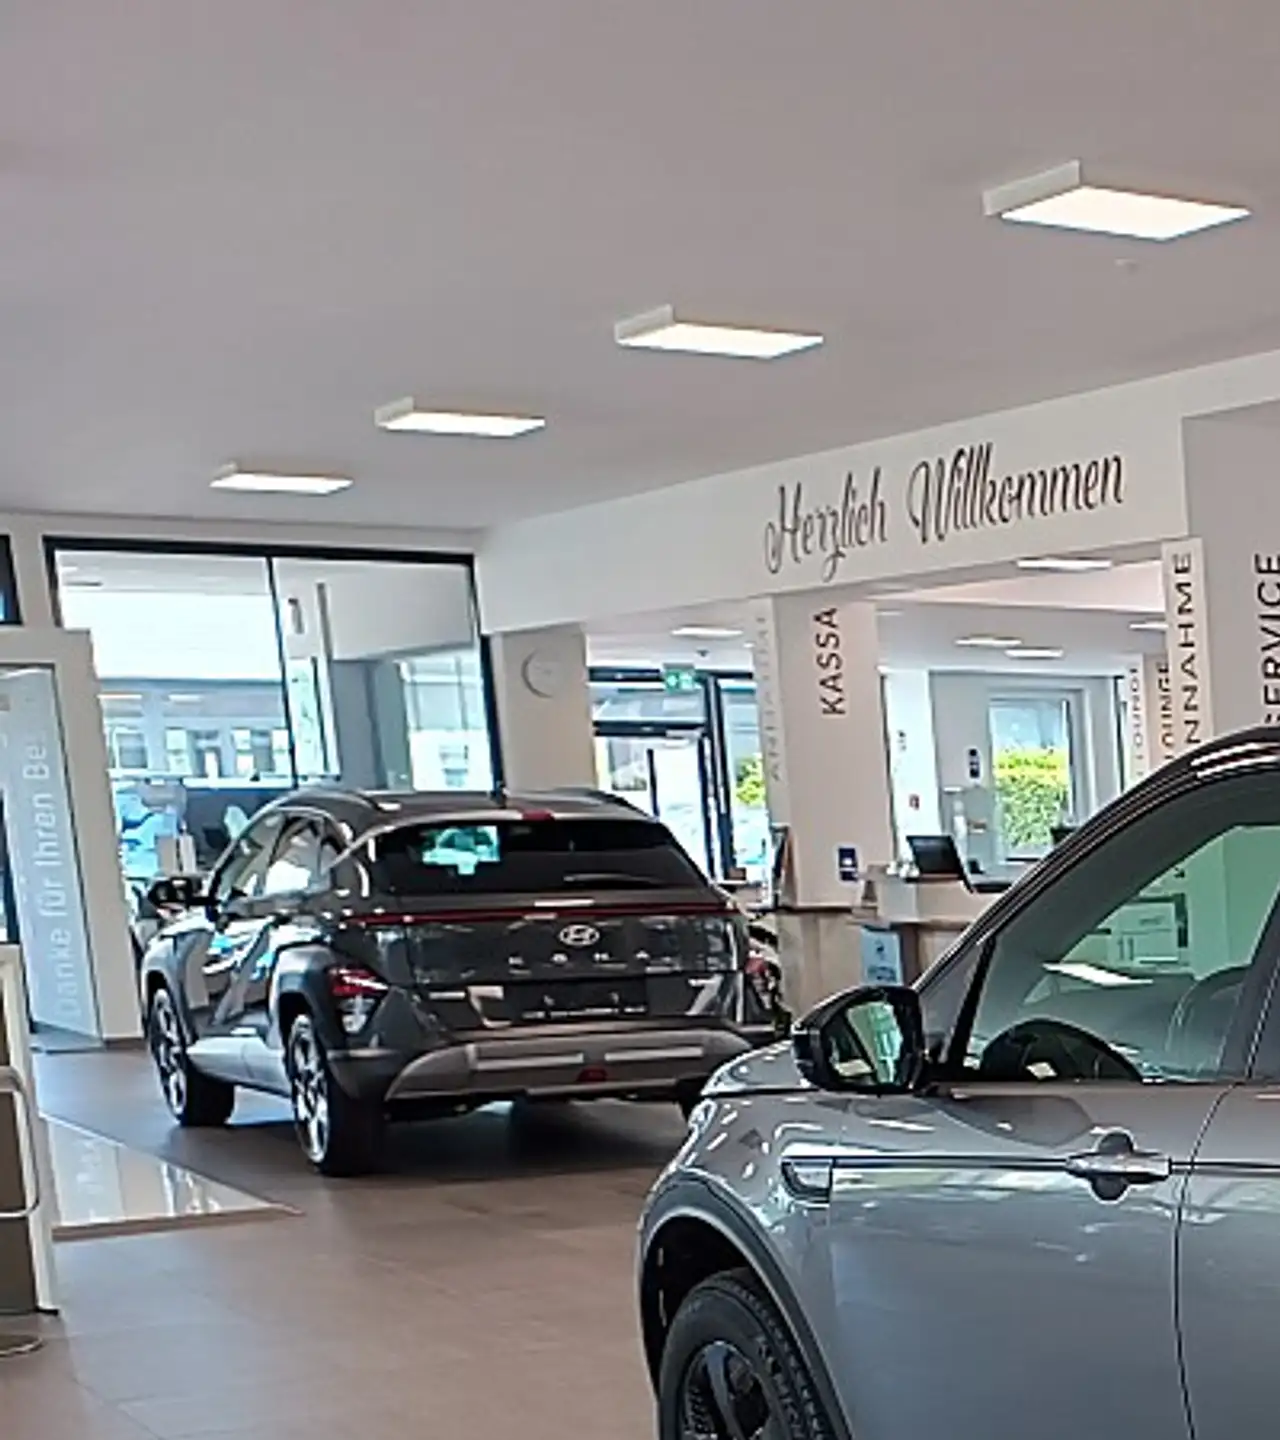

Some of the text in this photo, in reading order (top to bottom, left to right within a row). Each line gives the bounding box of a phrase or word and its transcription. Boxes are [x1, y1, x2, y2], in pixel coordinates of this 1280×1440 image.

[764, 441, 1124, 582] Herzlich Willkommen
[814, 607, 846, 716] KASSA
